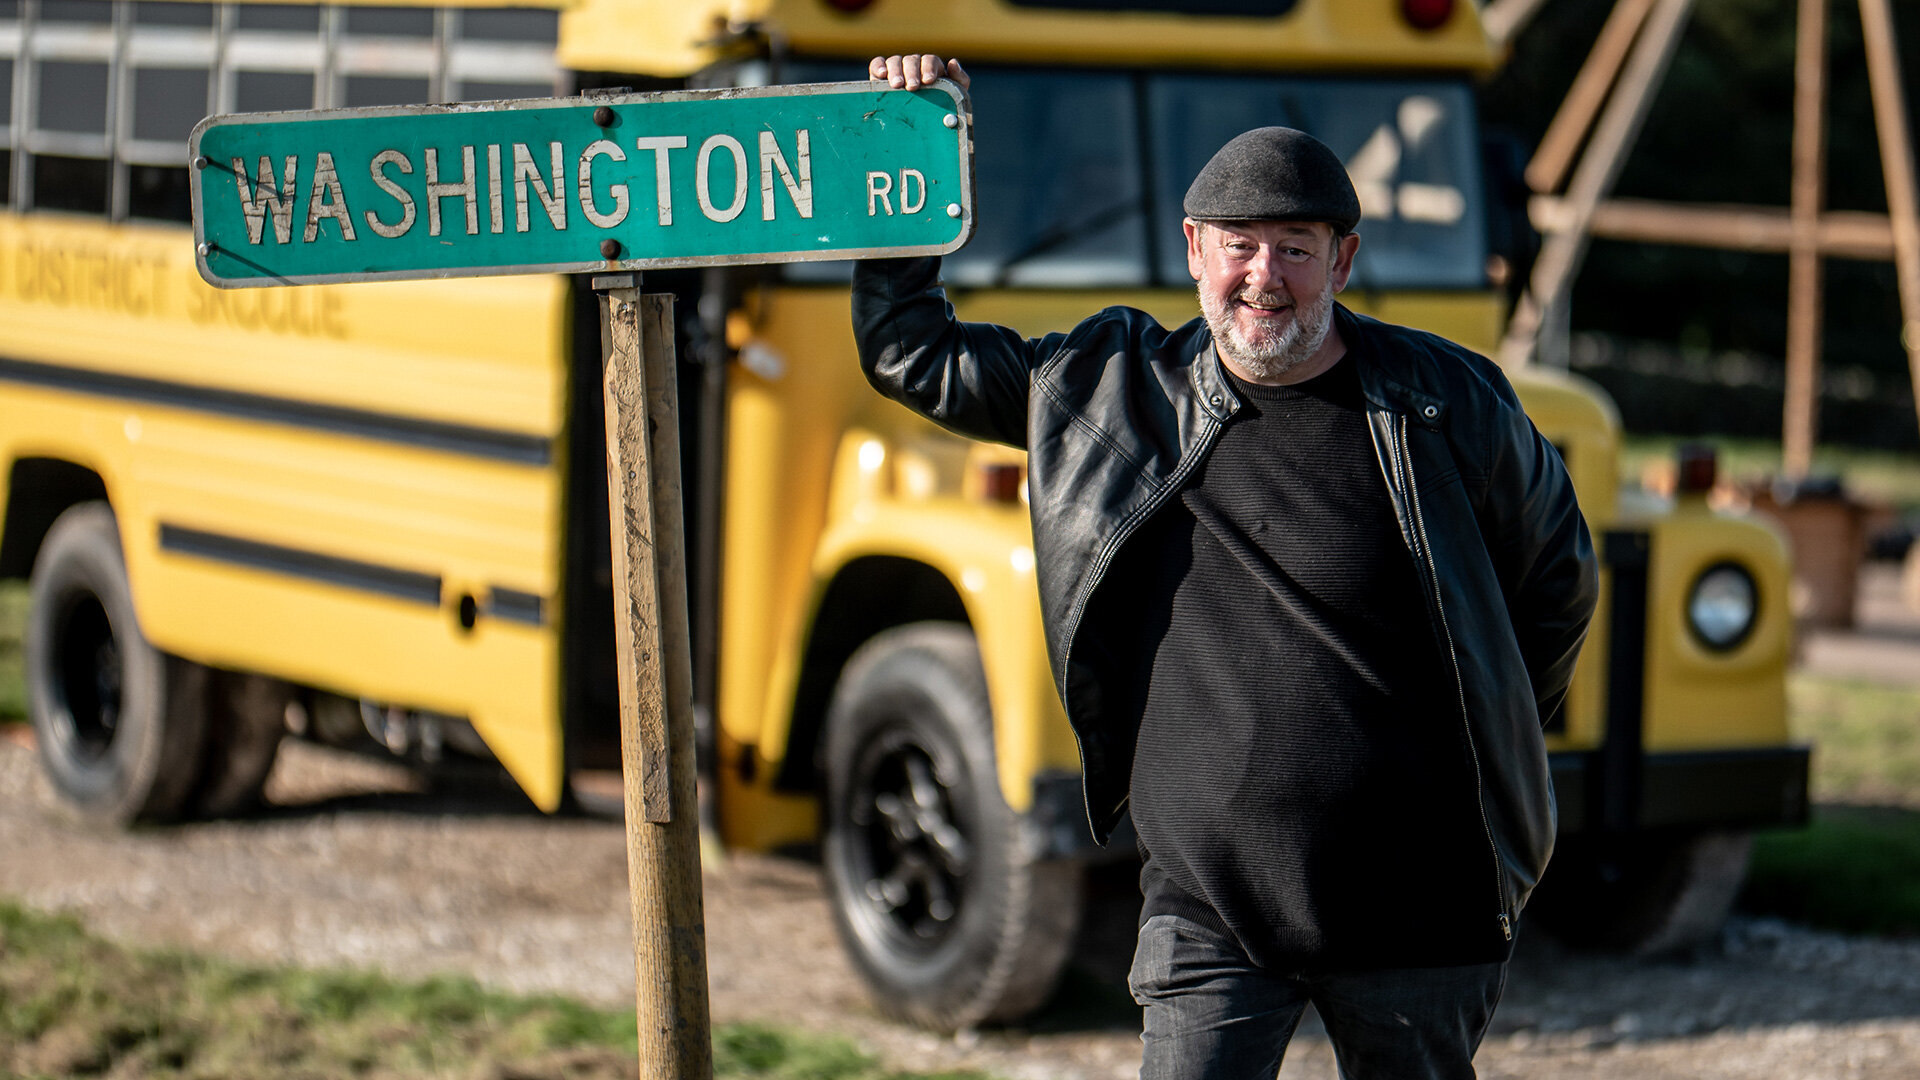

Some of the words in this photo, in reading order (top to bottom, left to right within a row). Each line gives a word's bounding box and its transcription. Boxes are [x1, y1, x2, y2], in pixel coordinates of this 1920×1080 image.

[231, 129, 813, 245] WASHINGTON
[866, 168, 927, 216] RD
[15, 241, 170, 317] DISTRICT
